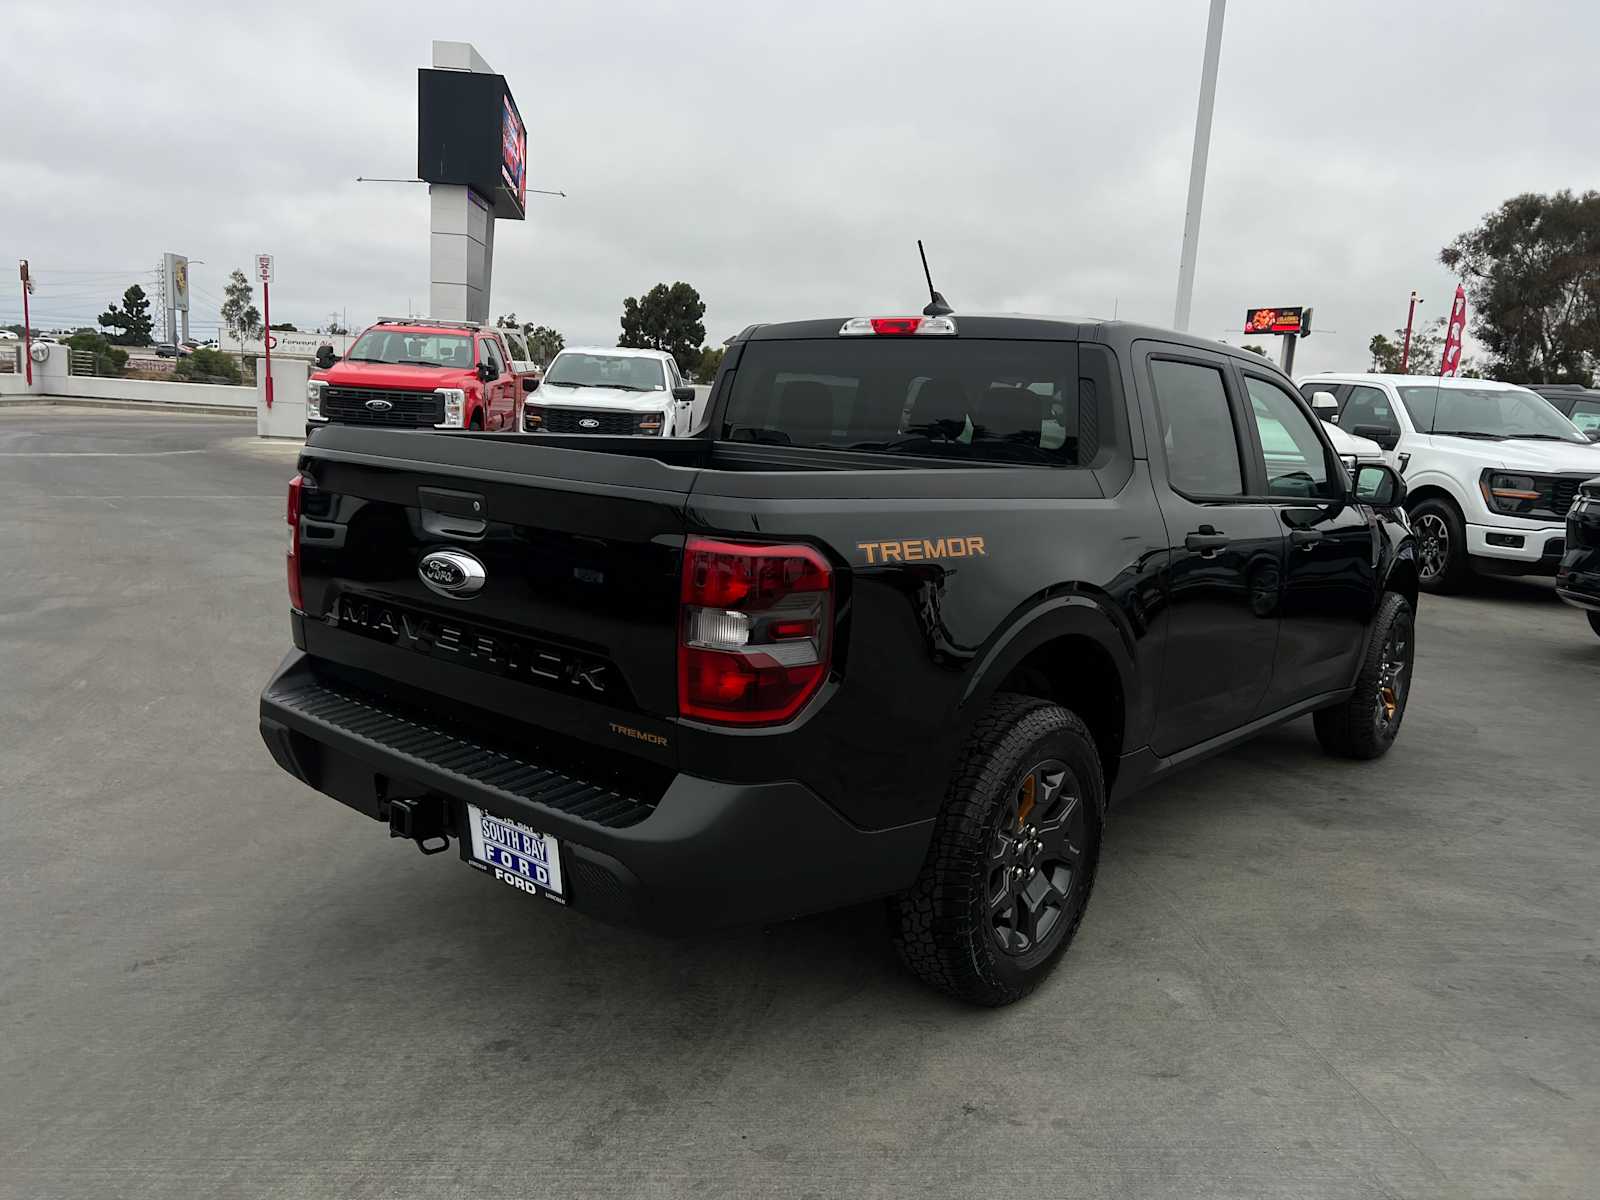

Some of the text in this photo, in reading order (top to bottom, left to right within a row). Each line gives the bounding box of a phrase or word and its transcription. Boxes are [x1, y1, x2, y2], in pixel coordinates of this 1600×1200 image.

[857, 536, 985, 564] TREMOR
[427, 560, 455, 582] Ford
[343, 604, 606, 691] MAVERICK
[609, 722, 668, 746] TREMOR
[482, 820, 520, 851] SOUTH
[522, 834, 545, 861] BAY
[485, 844, 548, 883] FORD
[494, 868, 536, 894] FORD
